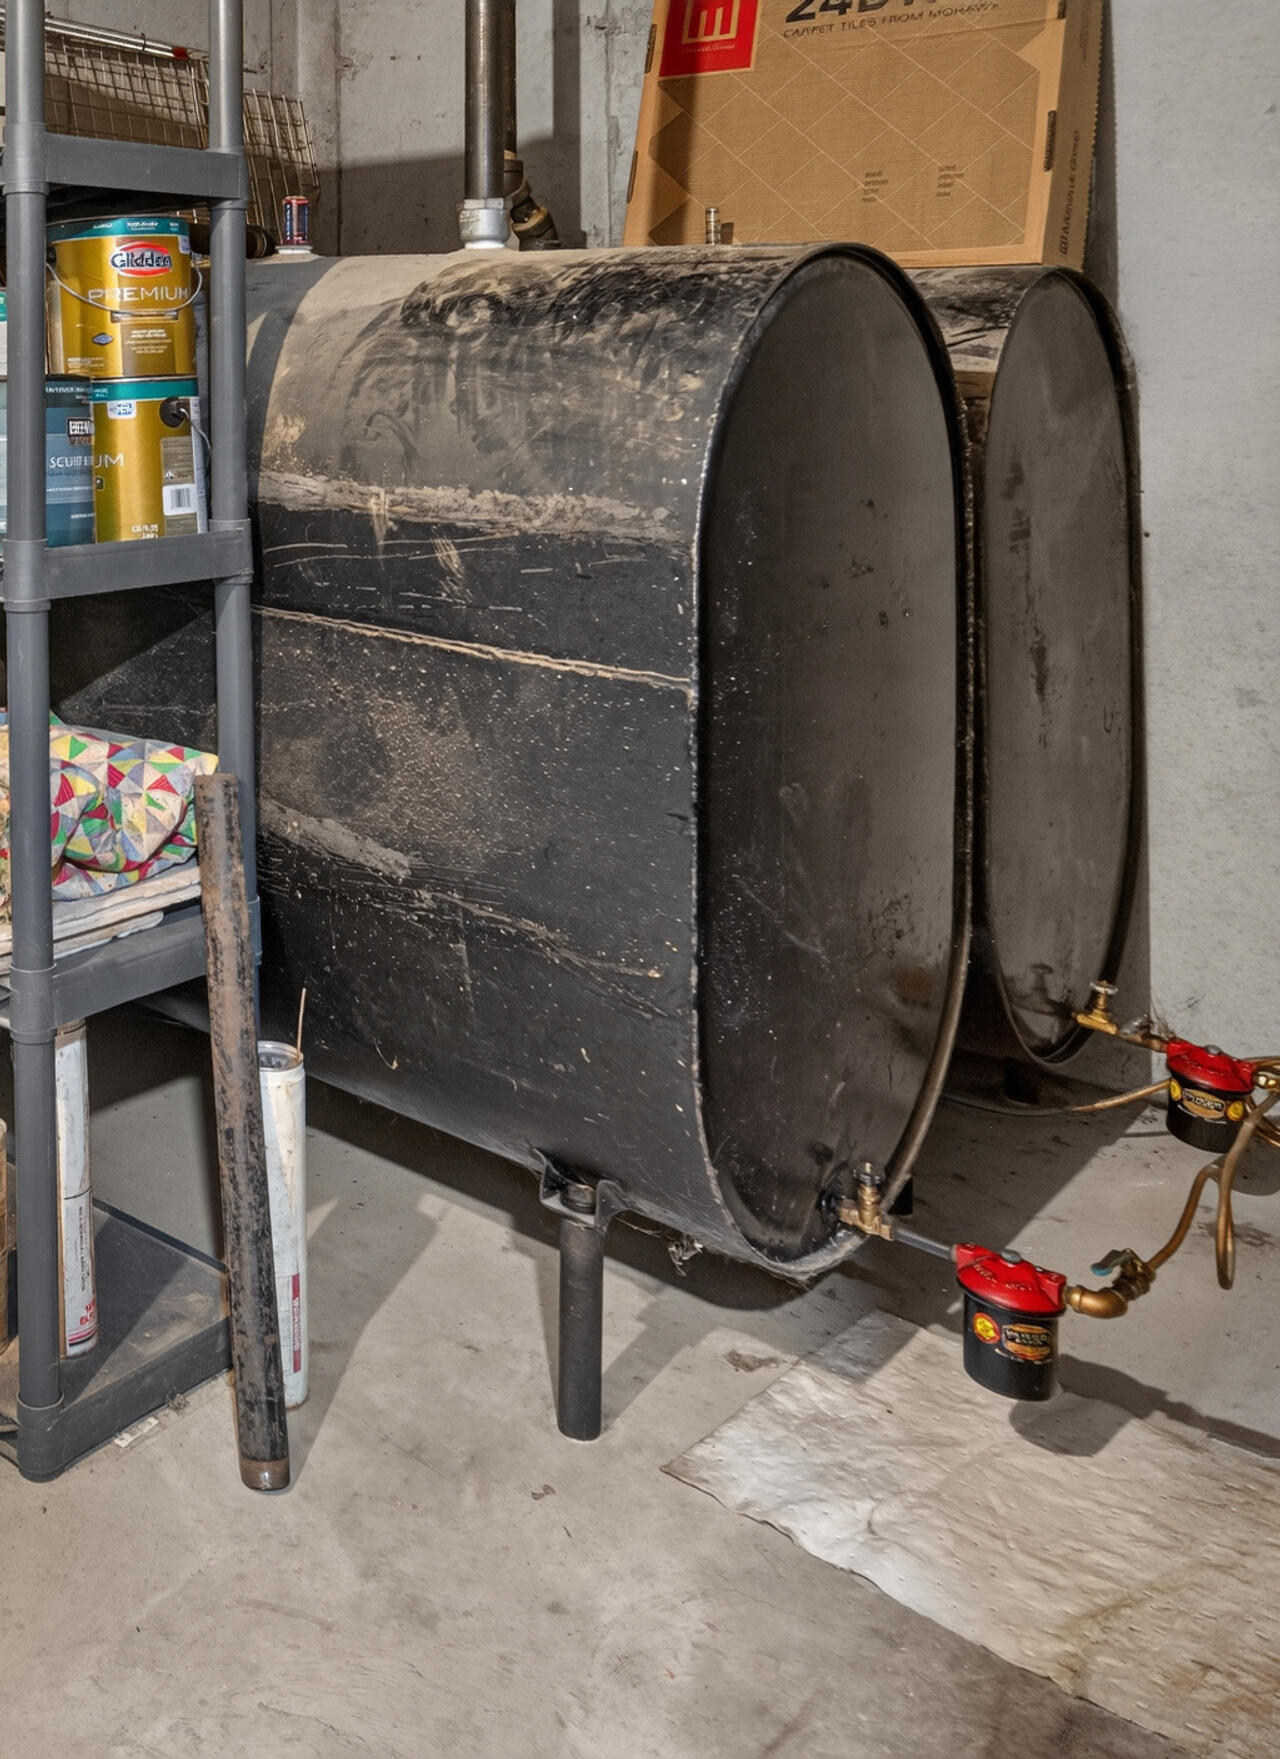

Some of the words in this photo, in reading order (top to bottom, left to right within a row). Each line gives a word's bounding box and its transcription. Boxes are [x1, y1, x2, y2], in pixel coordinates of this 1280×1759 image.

[841, 17, 877, 31] TILES
[110, 251, 173, 269] Glidden
[87, 287, 189, 302] PREMIUM
